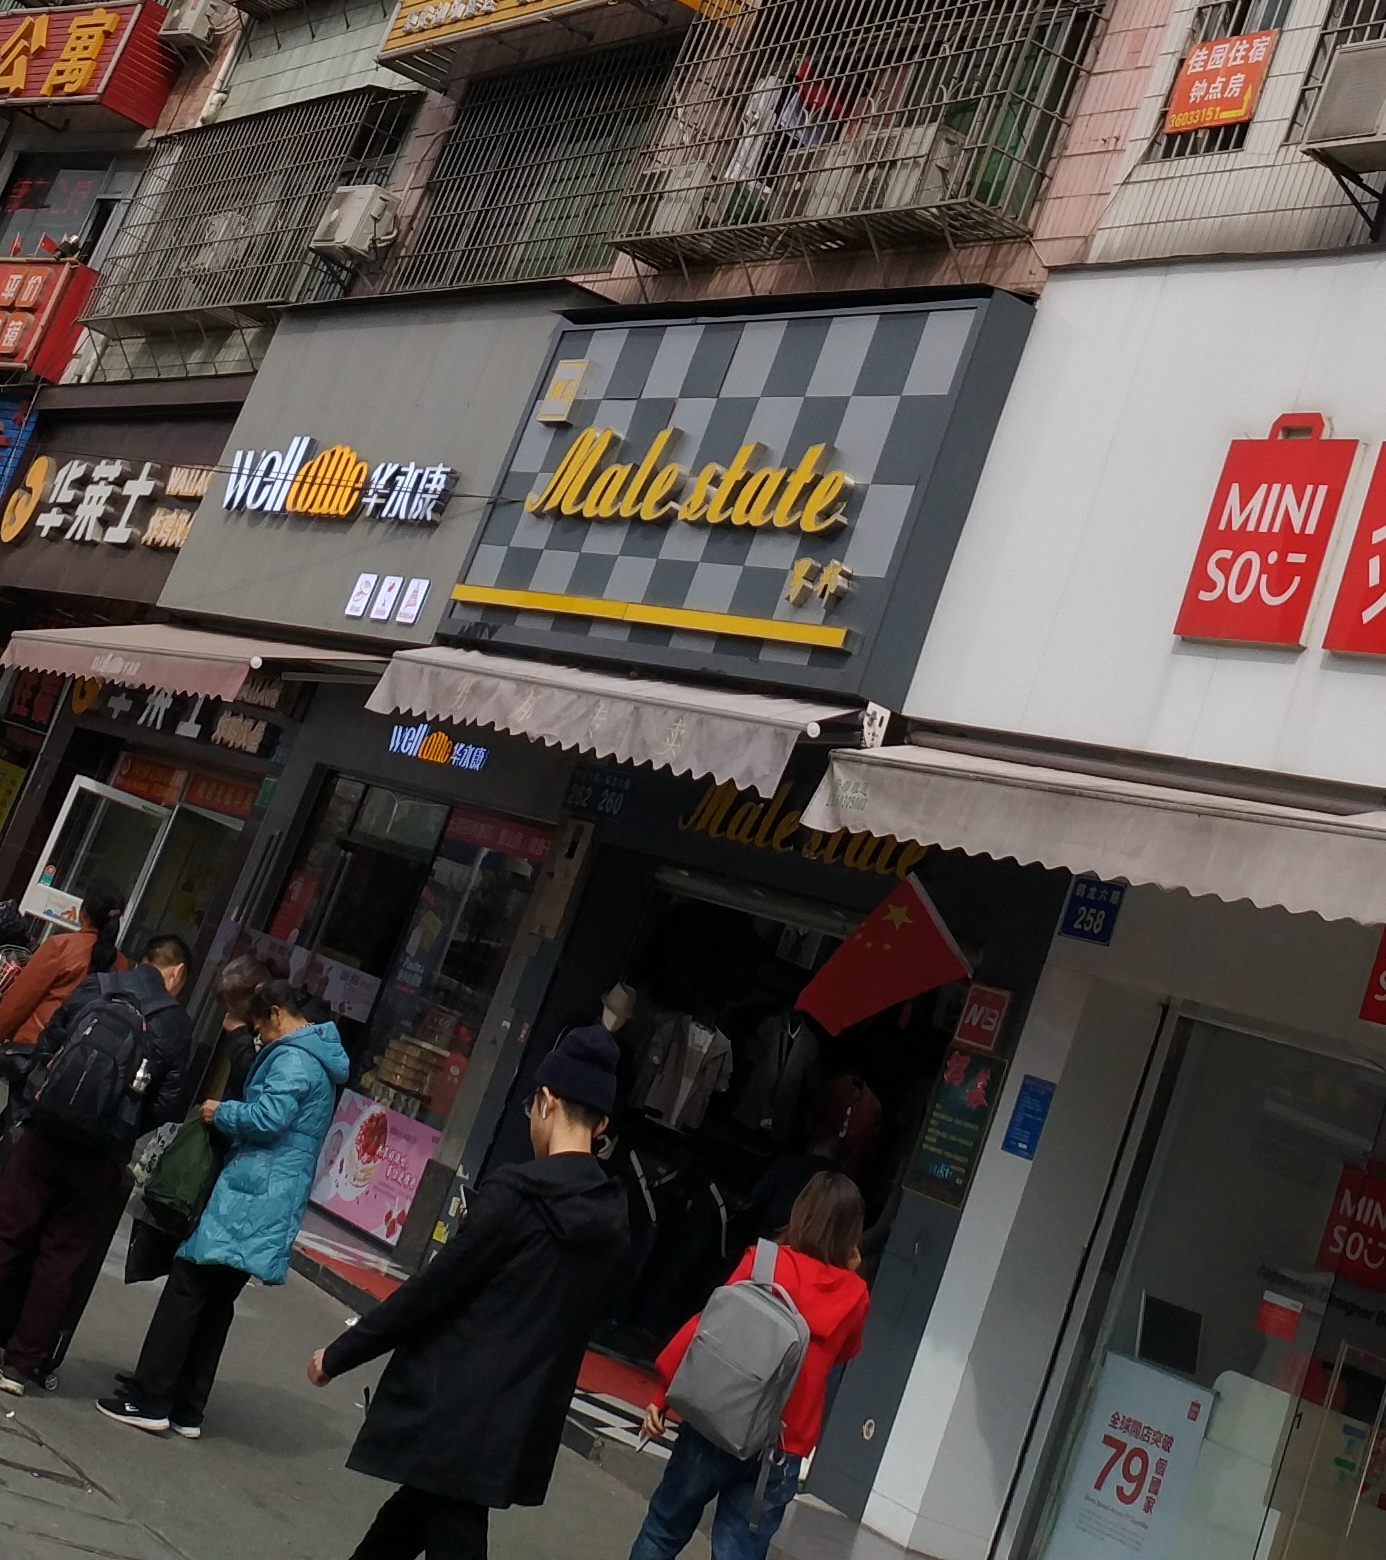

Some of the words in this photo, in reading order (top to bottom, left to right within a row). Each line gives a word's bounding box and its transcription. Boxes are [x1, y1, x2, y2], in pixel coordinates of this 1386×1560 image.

[1186, 35, 1272, 76] 佳园住宿
[1188, 72, 1246, 104] 钟点房
[1168, 106, 1222, 129] 36033151
[0, 272, 43, 307] 平价
[525, 426, 681, 522] Male
[678, 441, 850, 534] state
[35, 458, 158, 544] 华莱士
[1217, 482, 1329, 535] MINI
[1073, 905, 1106, 934] 258
[1093, 1433, 1150, 1506] 79
